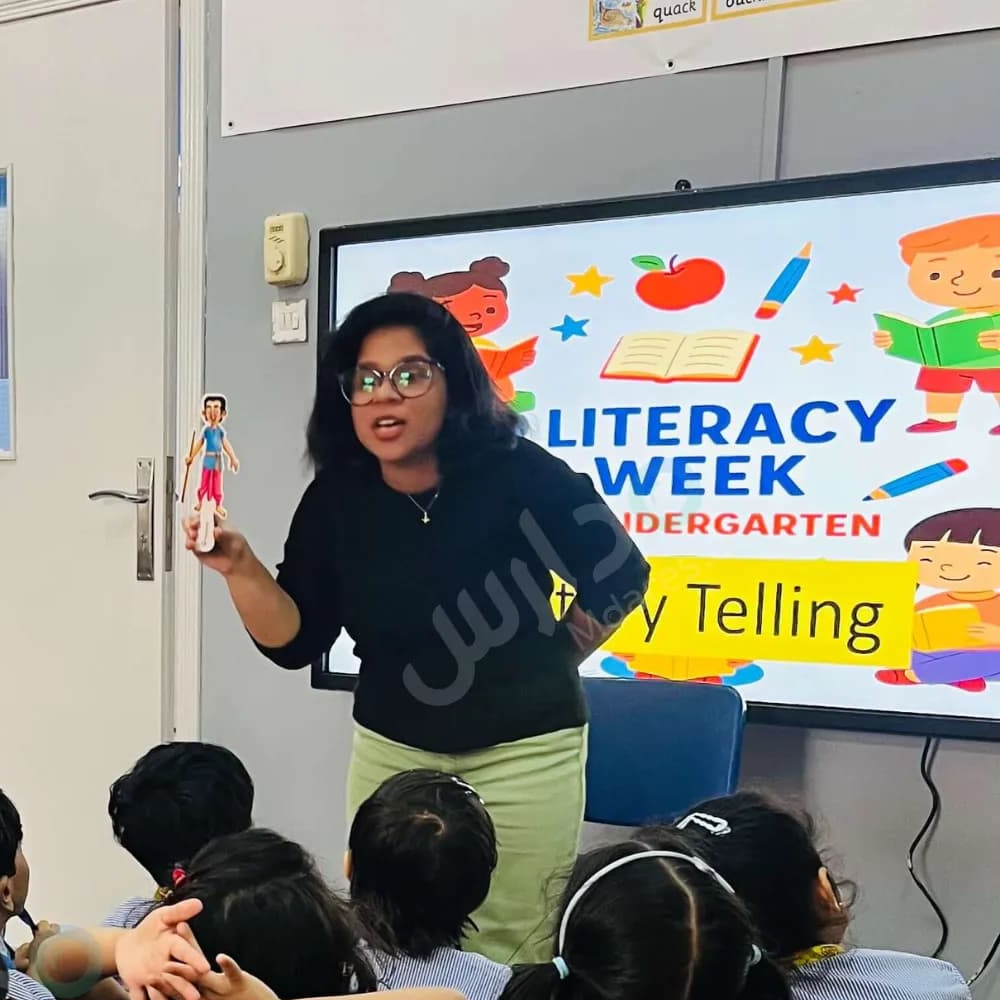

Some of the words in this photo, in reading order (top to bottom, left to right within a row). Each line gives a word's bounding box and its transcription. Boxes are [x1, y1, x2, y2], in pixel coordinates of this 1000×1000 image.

[653, 0, 696, 23] quack
[548, 399, 896, 447] LITERACY
[595, 455, 806, 496] WEEK
[624, 512, 881, 537] DERGARTEN
[687, 582, 884, 654] Telling
